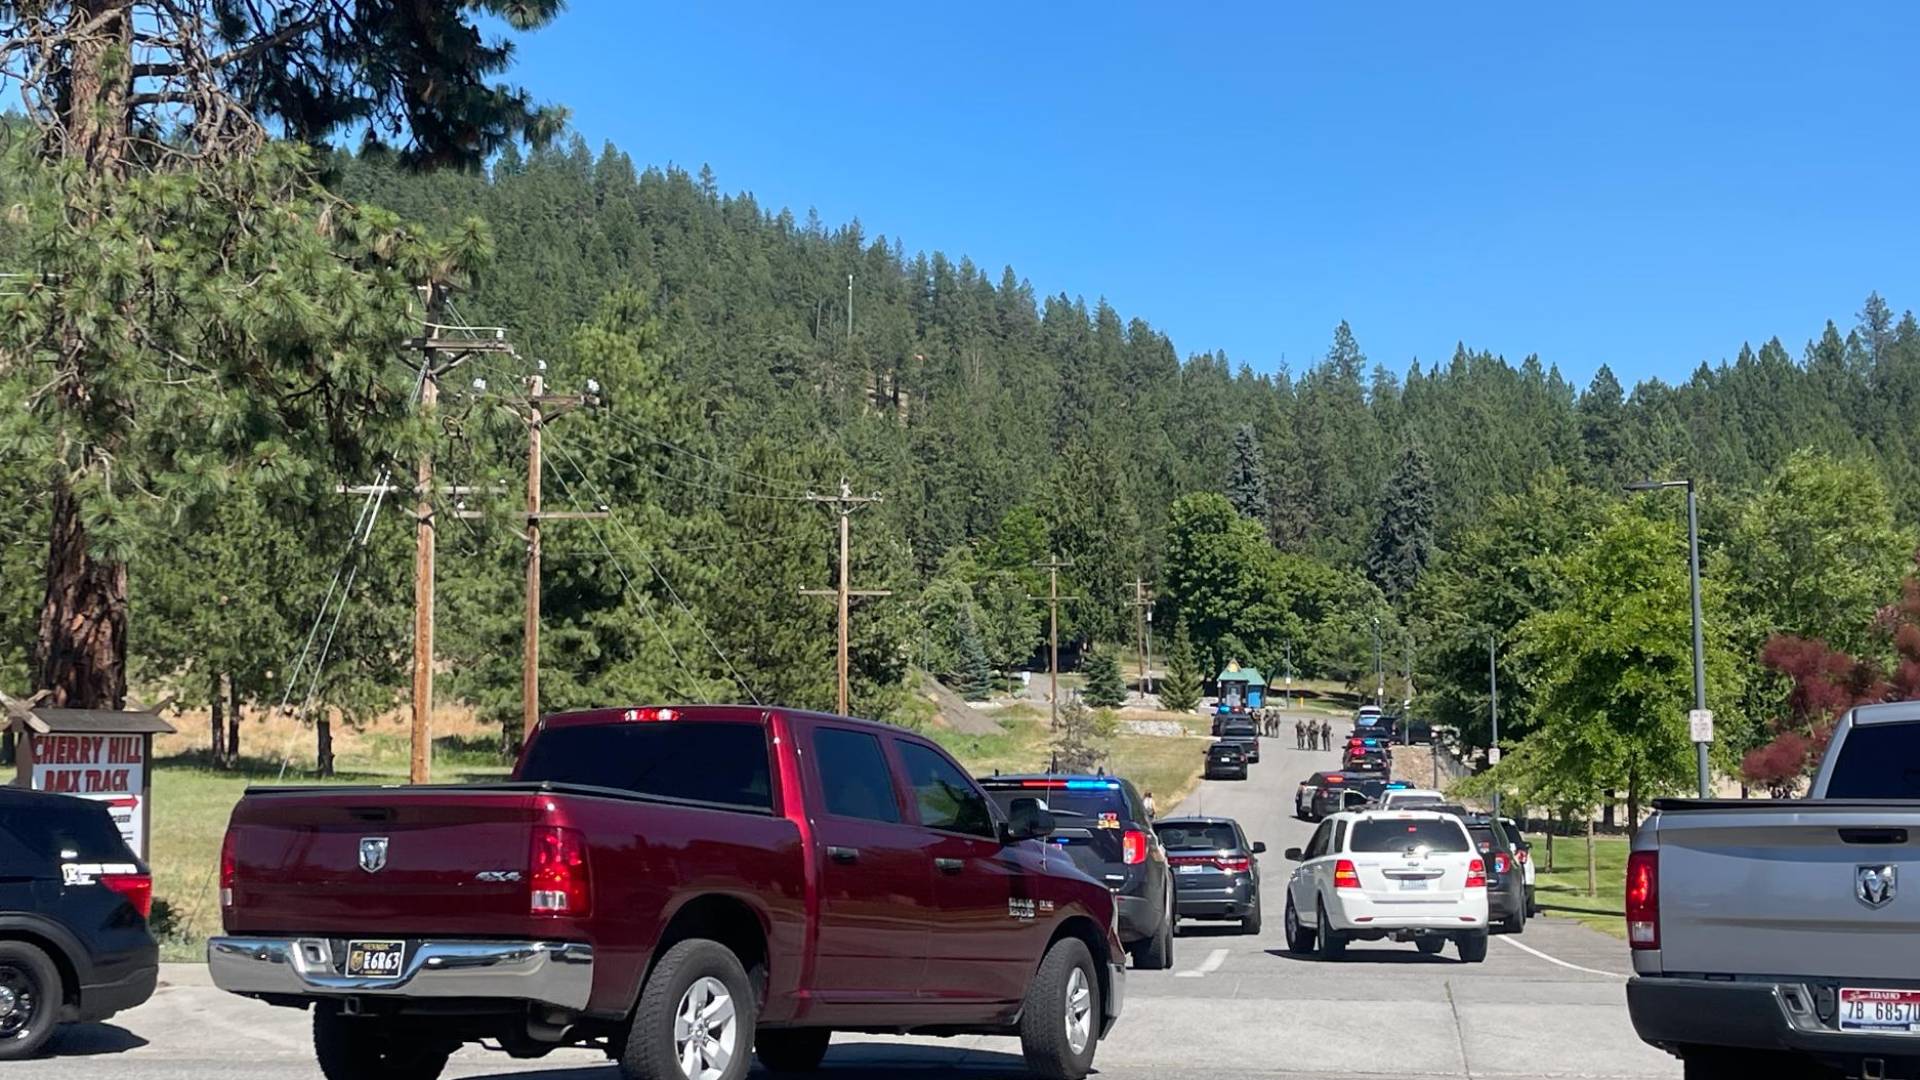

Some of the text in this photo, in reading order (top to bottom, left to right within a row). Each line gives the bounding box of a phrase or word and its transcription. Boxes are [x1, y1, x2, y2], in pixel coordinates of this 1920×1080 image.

[32, 735, 142, 765] CHERRY HILL
[44, 769, 130, 792] BMX TRACK
[1870, 991, 1901, 1000] IDAHO
